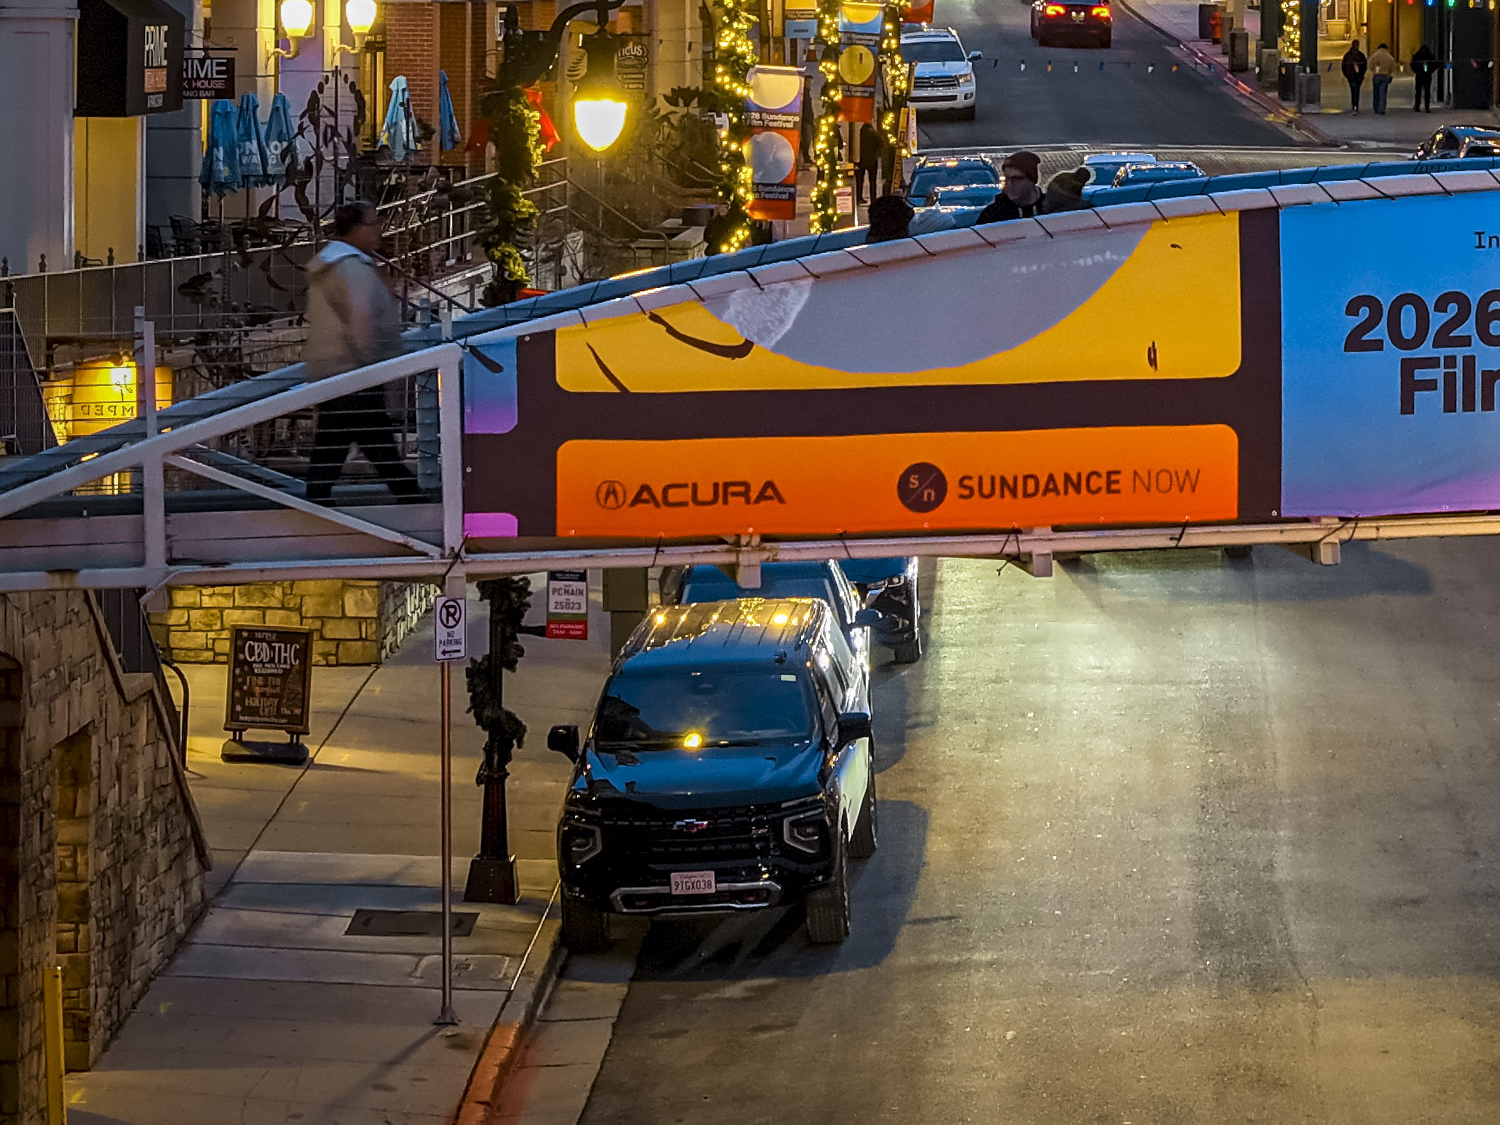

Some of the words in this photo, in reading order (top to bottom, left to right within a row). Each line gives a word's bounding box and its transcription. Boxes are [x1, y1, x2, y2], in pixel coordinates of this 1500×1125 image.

[761, 112, 800, 122] Sundance
[764, 120, 794, 128] Festival
[1475, 232, 1500, 249] In
[957, 469, 1122, 500] SUNDANCE
[1133, 468, 1201, 494] NOW
[629, 480, 786, 508] ACURA
[552, 587, 584, 597] PCMAIN
[438, 638, 463, 648] PARKING
[674, 879, 713, 892] 9TGX038
